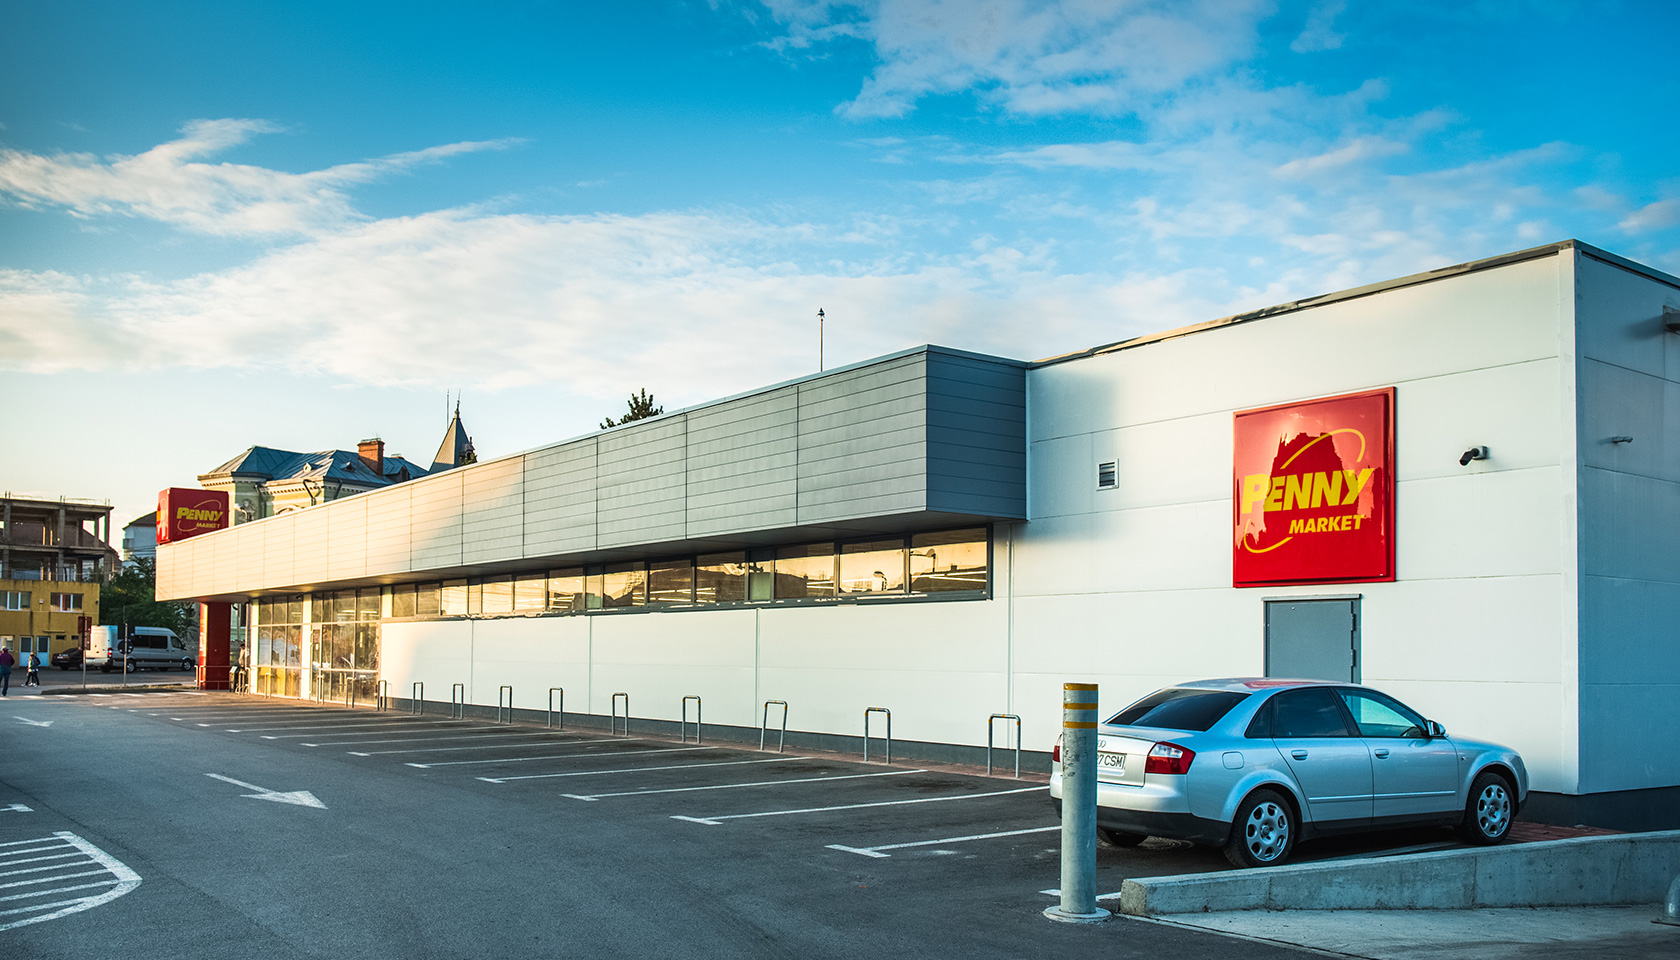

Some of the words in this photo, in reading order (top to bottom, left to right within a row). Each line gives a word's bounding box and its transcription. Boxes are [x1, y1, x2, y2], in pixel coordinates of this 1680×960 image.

[1241, 467, 1375, 514] PENNY
[177, 507, 223, 521] PENNY
[1288, 514, 1364, 534] MARKET
